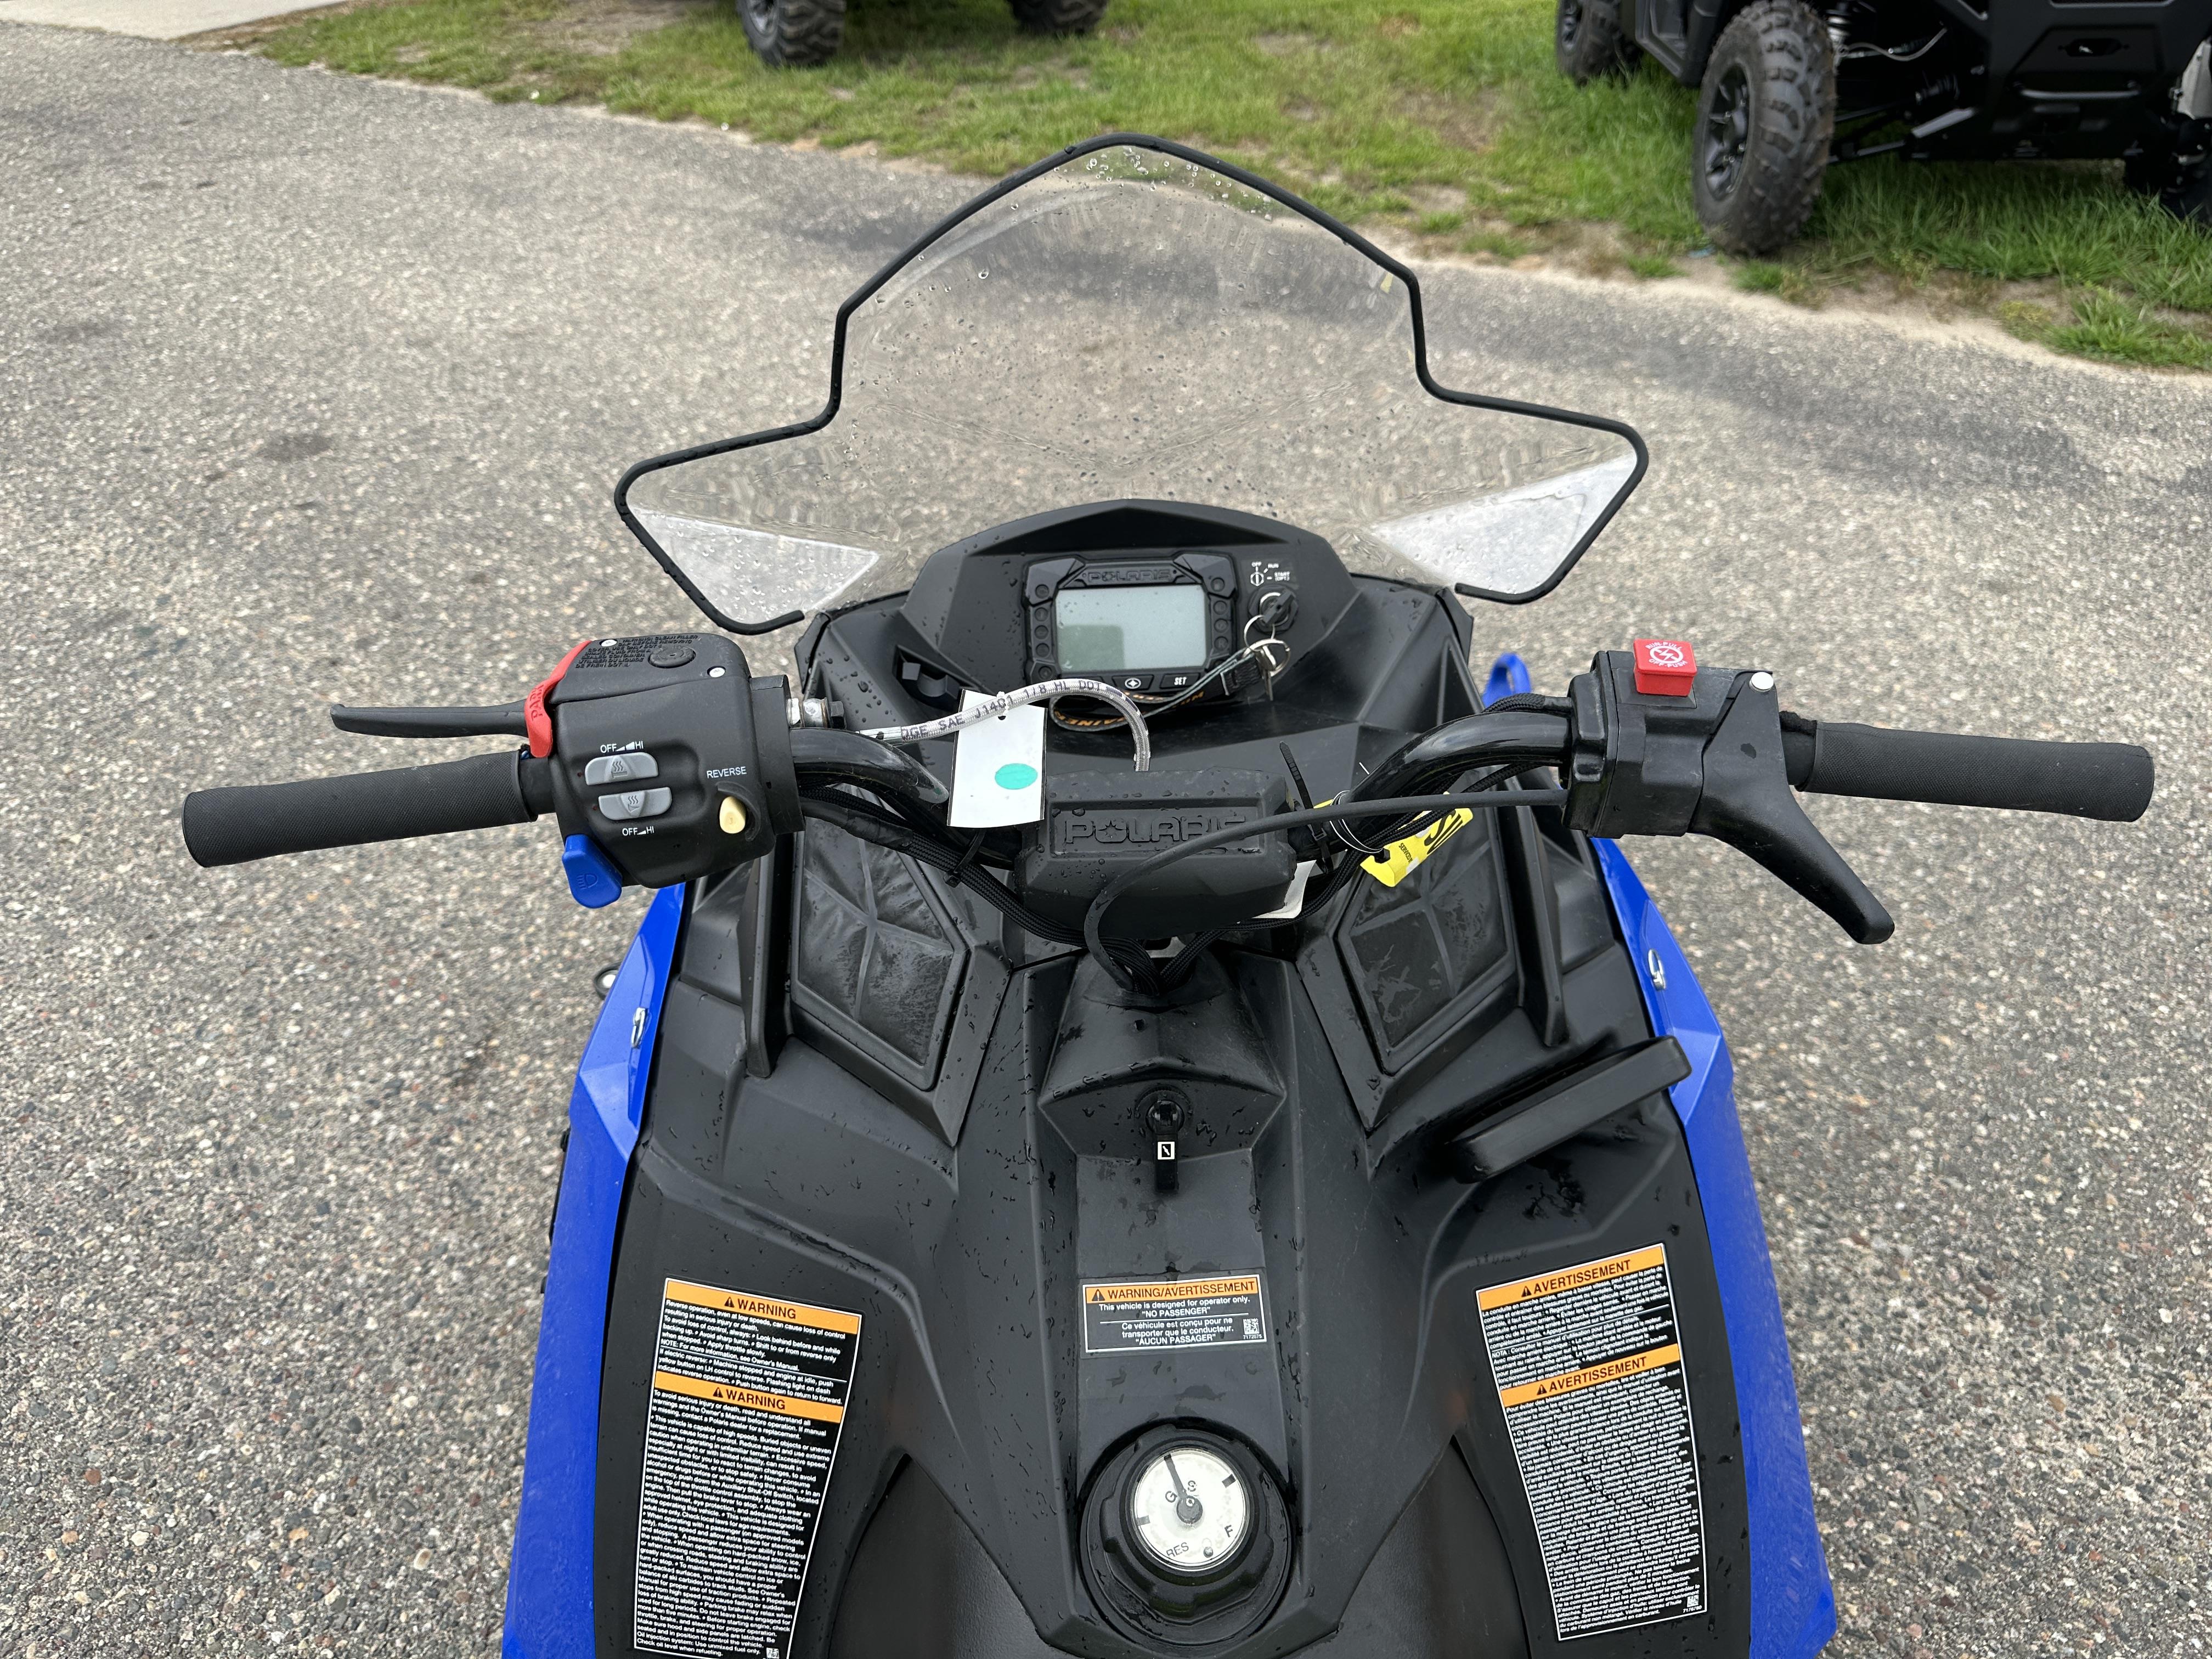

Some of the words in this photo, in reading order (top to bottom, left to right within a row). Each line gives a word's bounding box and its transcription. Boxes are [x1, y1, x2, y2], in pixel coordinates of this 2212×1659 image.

[1088, 569, 1171, 582] POLARIS
[1645, 642, 1682, 651] RUN-PULL
[1648, 658, 1688, 668] OFF-PUSH
[1174, 676, 1187, 685] SET
[530, 685, 544, 721] PARK
[939, 714, 966, 731] SAE
[1054, 680, 1070, 691] HL
[1079, 680, 1102, 691] DOT
[600, 743, 617, 753] OFF
[635, 741, 644, 749] HI
[707, 766, 747, 778] REVERSE
[622, 827, 637, 836] OFF
[1534, 1260, 1630, 1294] AVERTISSEMENT
[1107, 1282, 1255, 1299] WARNING/AVERTISSEMENT
[737, 1298, 796, 1319] WARNING
[1116, 1302, 1142, 1310] vehicle
[1152, 1300, 1185, 1309] designed
[1199, 1297, 1231, 1306] operator
[1232, 1296, 1250, 1304] only.
[664, 1308, 689, 1318] resulting
[695, 1314, 716, 1323] serious
[716, 1317, 732, 1327] injury
[666, 1300, 688, 1309] Reverse
[803, 1325, 816, 1334] loss
[824, 1331, 845, 1339] control
[1121, 1330, 1163, 1338] transporter
[1189, 1325, 1233, 1334] conducteur.
[663, 1323, 684, 1334] backing
[698, 1330, 715, 1339] Avoid
[716, 1334, 732, 1343] sharp
[755, 1341, 770, 1349] Shift
[785, 1346, 799, 1355] from
[800, 1351, 822, 1359] reverse
[823, 1355, 837, 1363] only
[707, 1340, 724, 1350] Apply
[725, 1342, 746, 1352] throttle
[756, 1333, 771, 1341] Look
[772, 1336, 792, 1345] behind
[792, 1340, 811, 1349] before
[1549, 1356, 1646, 1392] AVERTISSEMENT
[726, 1389, 786, 1410] WARNING
[1224, 1524, 1233, 1538] F
[1166, 1542, 1189, 1558] RES
[646, 1633, 670, 1641] injection
